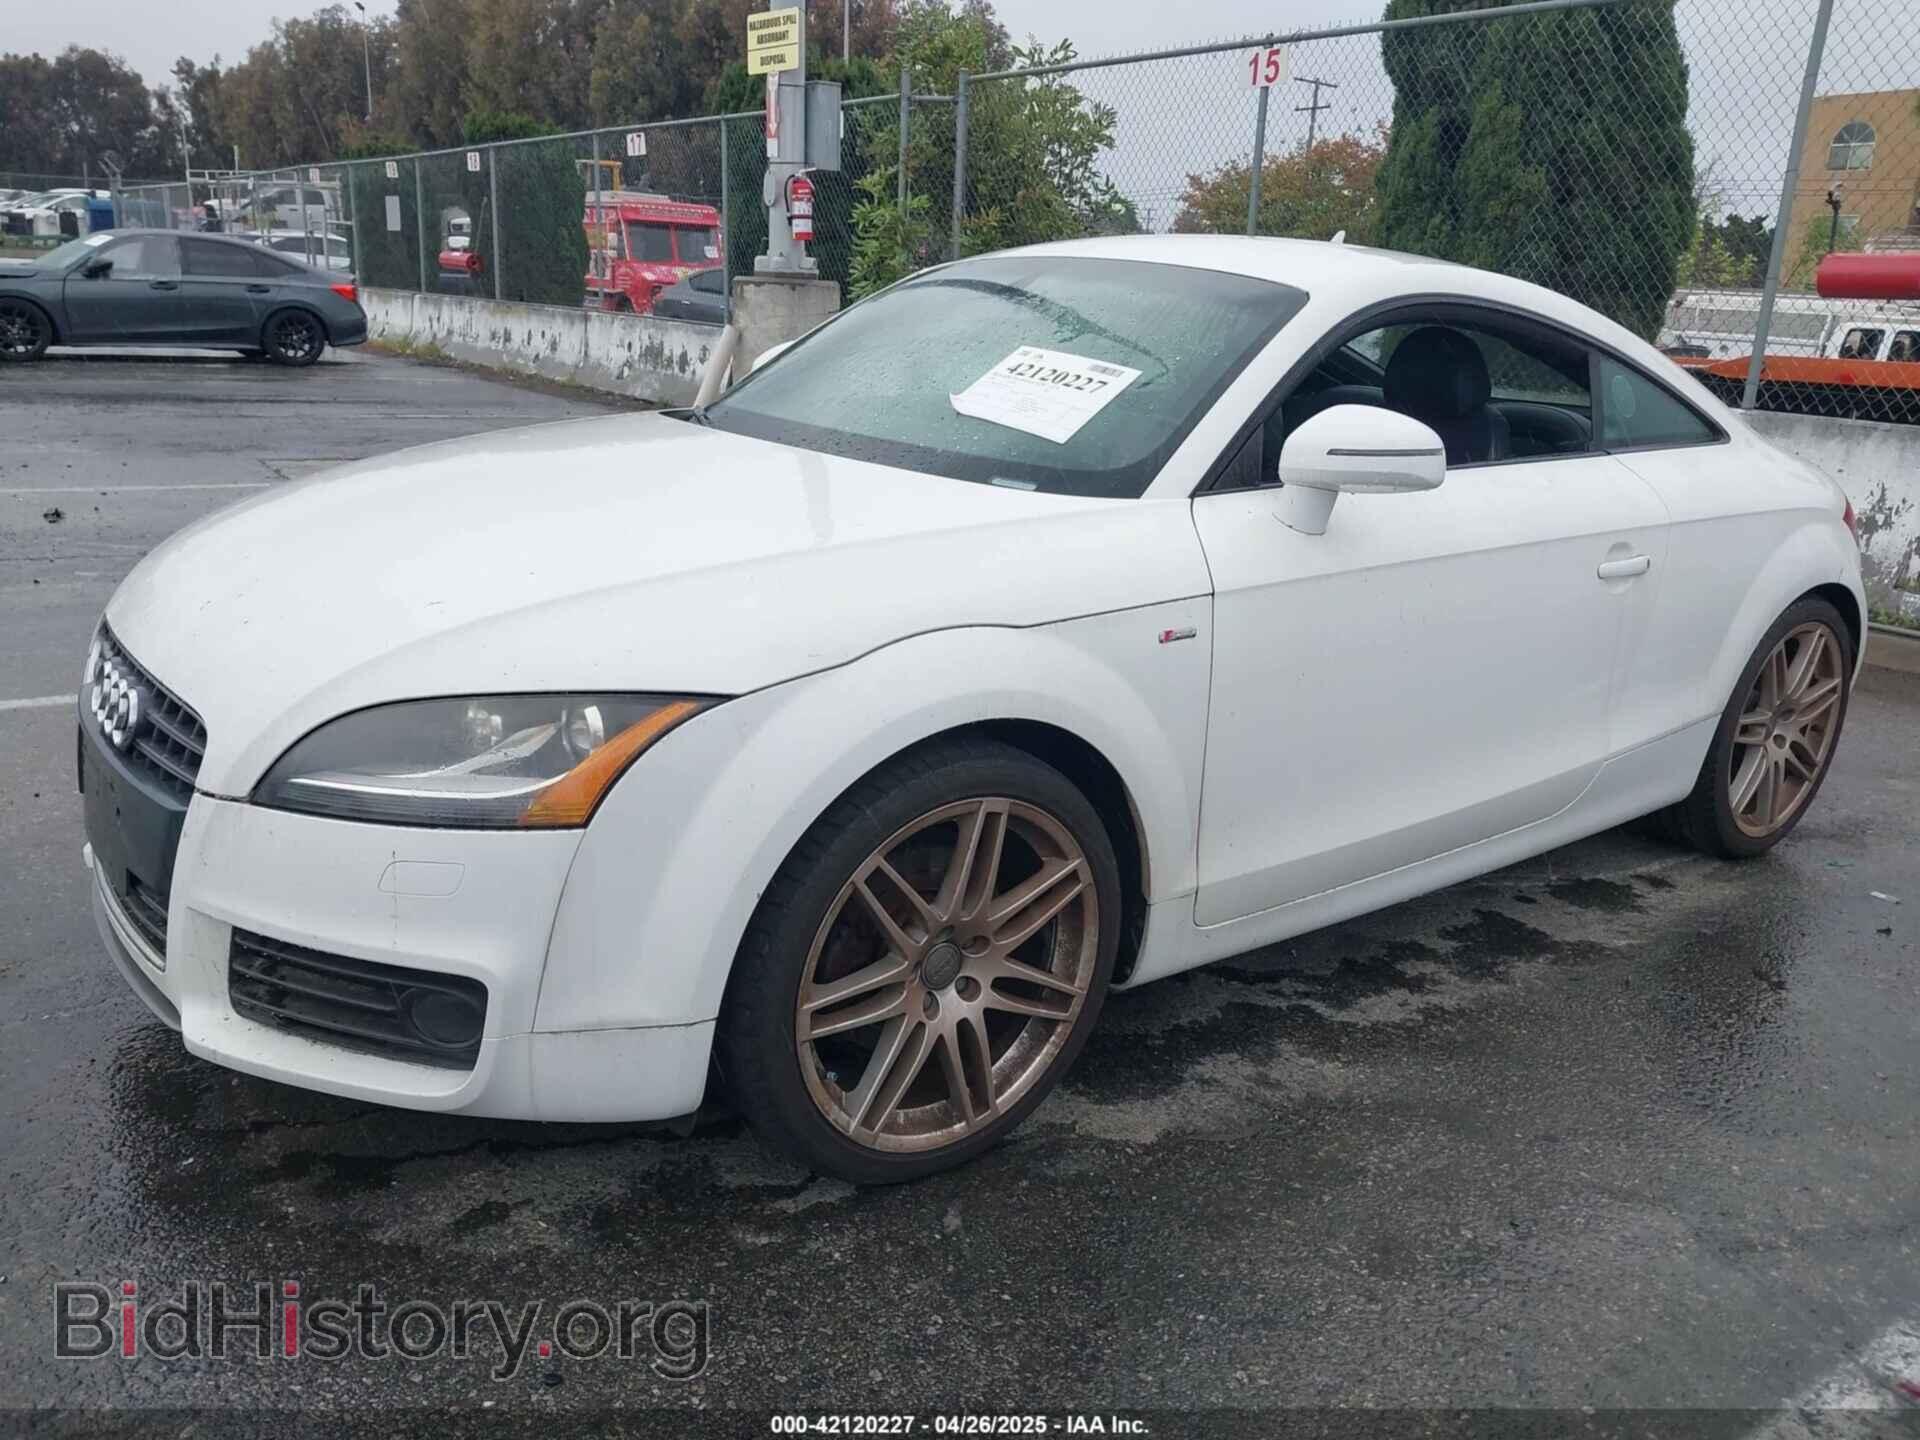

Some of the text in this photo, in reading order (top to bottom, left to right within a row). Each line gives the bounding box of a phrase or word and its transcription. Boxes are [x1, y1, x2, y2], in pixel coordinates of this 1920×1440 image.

[749, 14, 797, 31] HAZARDOUS SPILL
[760, 53, 786, 67] DISPOSAL
[1249, 49, 1280, 85] 15
[630, 134, 642, 154] 17
[1007, 363, 1108, 394] 42120227
